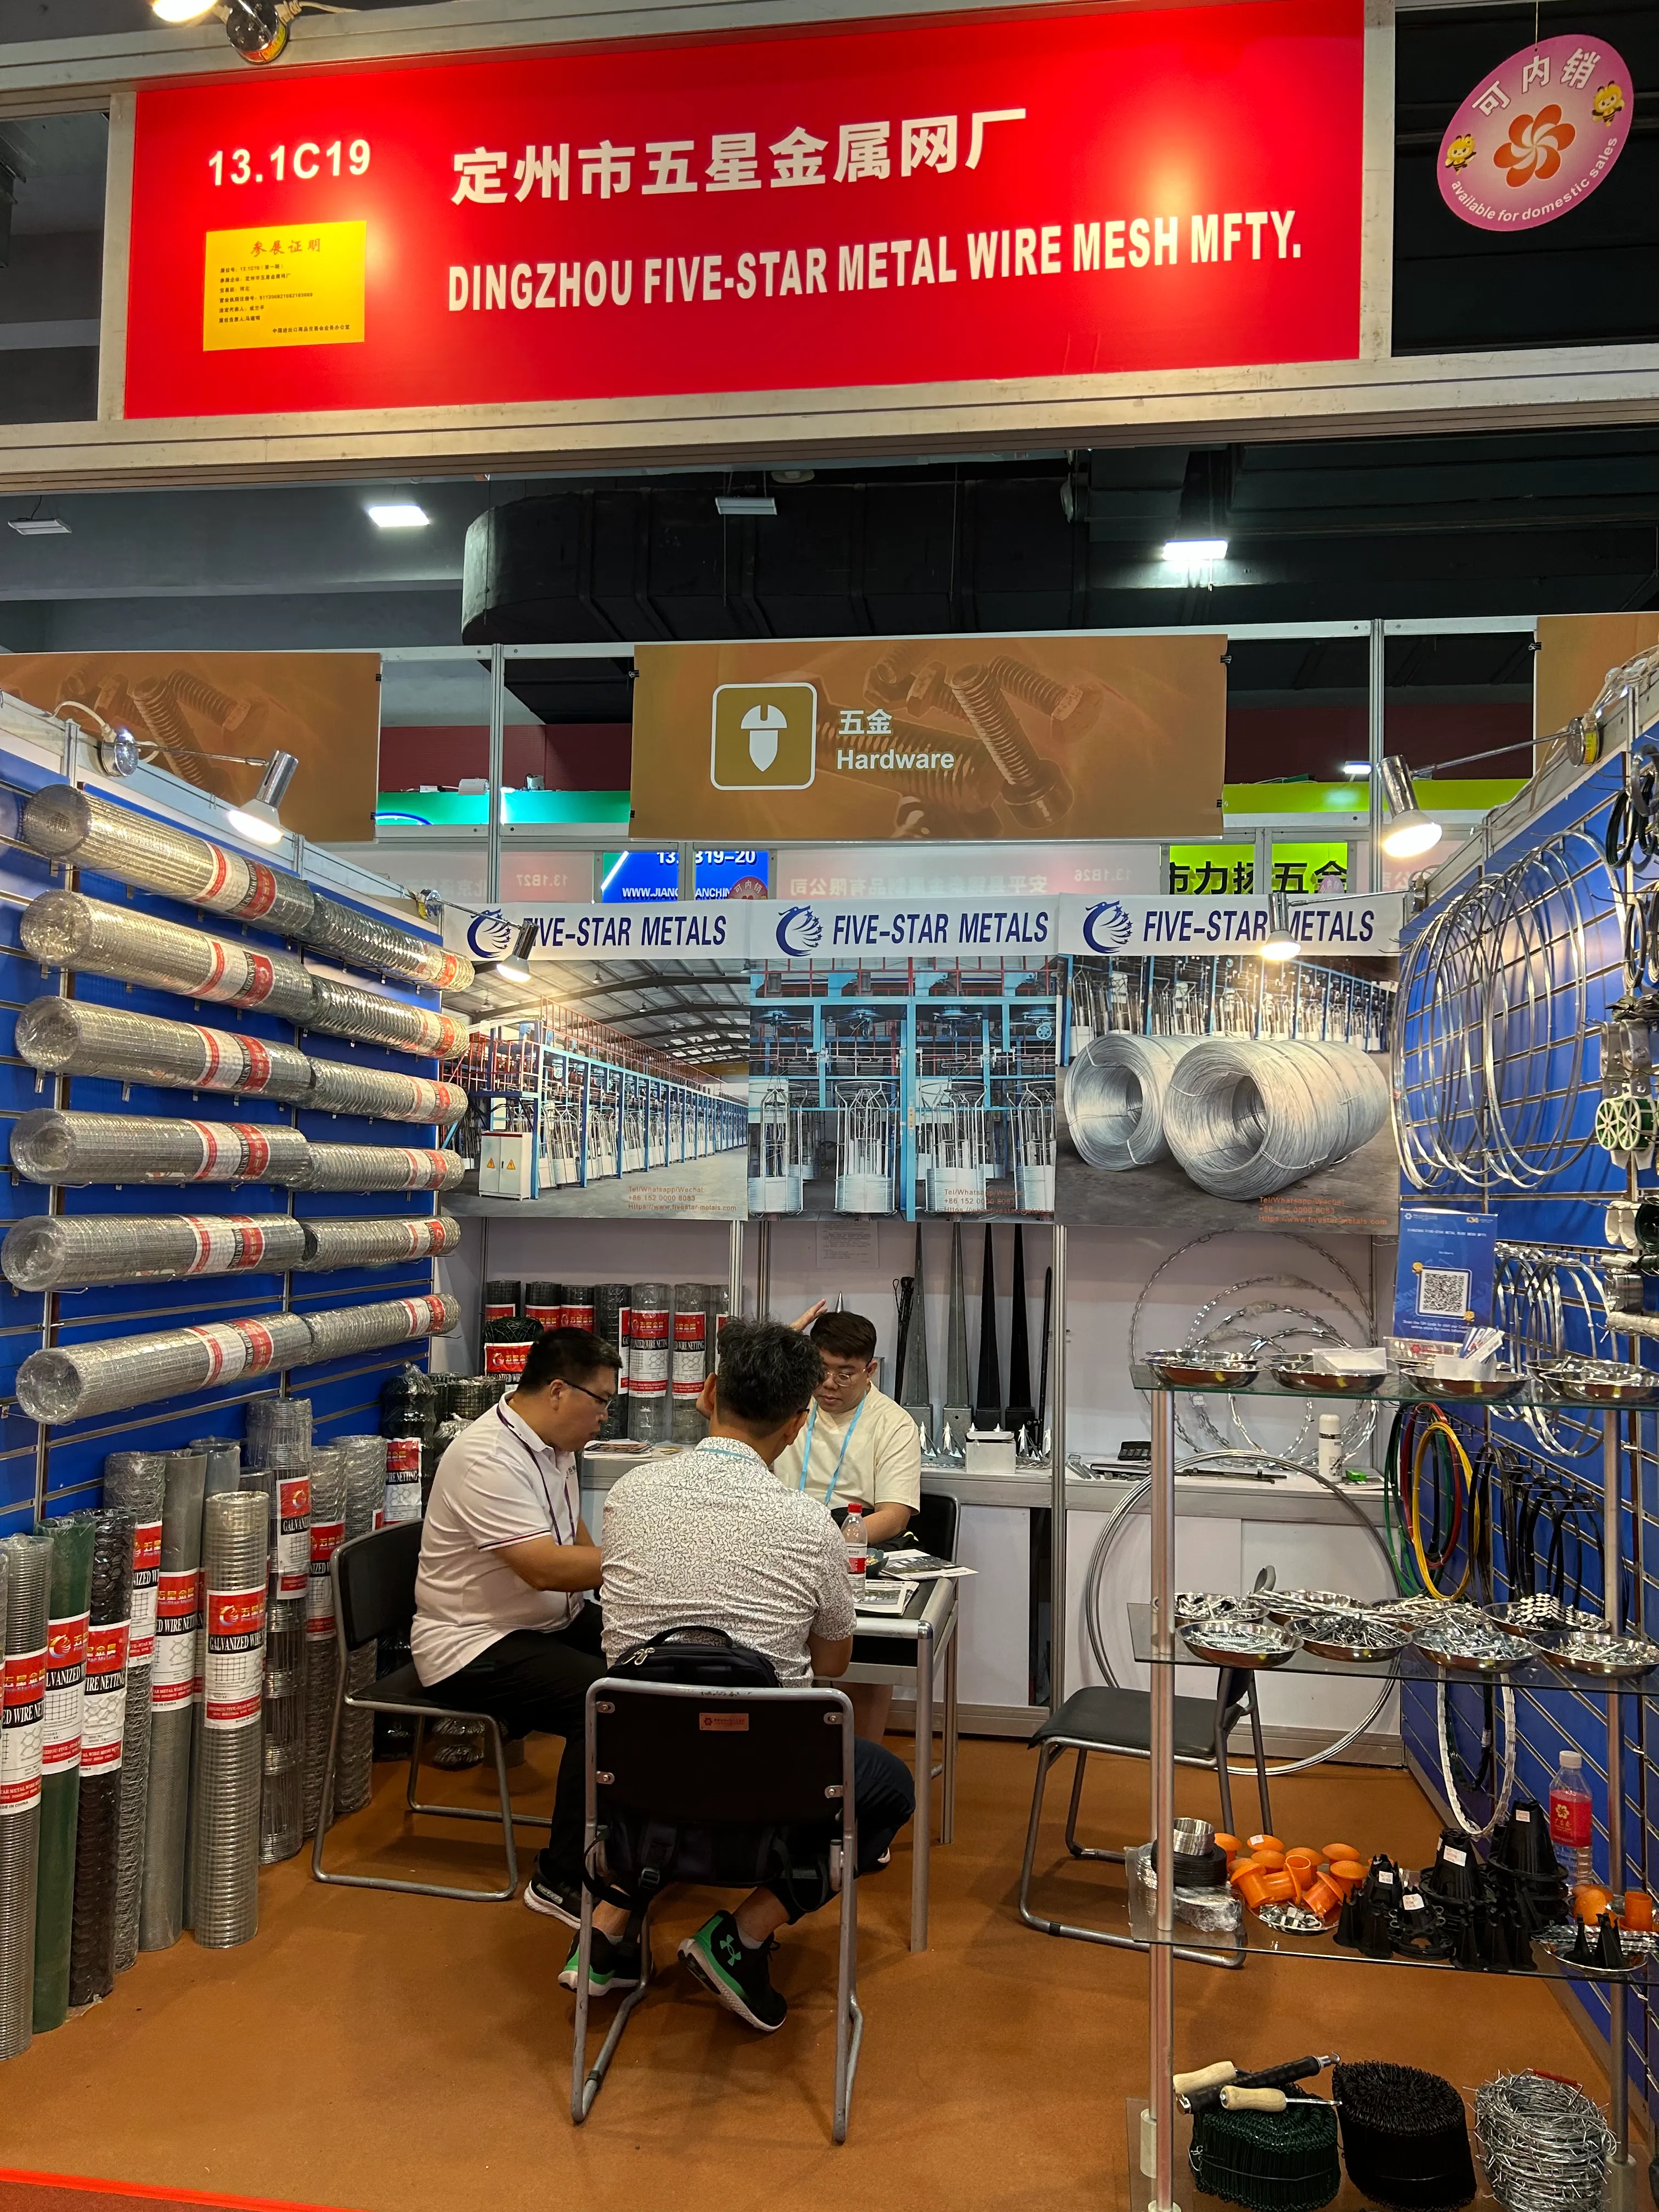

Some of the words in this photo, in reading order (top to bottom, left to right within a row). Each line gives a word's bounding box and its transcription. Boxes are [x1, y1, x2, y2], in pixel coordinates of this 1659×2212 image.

[1472, 48, 1600, 116] 可内销
[208, 139, 370, 185] 13.1C19
[450, 108, 1026, 205] 定州市五星金属网厂
[1452, 180, 1496, 219] available
[1498, 210, 1520, 222] for
[1522, 178, 1590, 219] domestic
[1589, 137, 1617, 178] sales
[251, 239, 321, 257] 参展证明
[449, 261, 632, 312] DINGZHOU
[644, 248, 827, 304] FIVE-STAR
[838, 236, 956, 291] METAL
[968, 226, 1060, 280] WIRE
[1073, 216, 1178, 272] MESH
[1191, 210, 1301, 263] MFTY.
[838, 709, 893, 736] 五金
[836, 748, 955, 770] Hardware
[734, 880, 763, 894] 可内销
[524, 916, 631, 947] VE-STAR
[640, 915, 726, 946] METALS
[833, 913, 948, 945] FIVE-STAR
[959, 912, 1048, 943] METALS
[1143, 910, 1267, 942] FIVE-STAR
[242, 1049, 252, 1065] WIRE
[241, 1140, 250, 1154] WIRE
[164, 1617, 182, 1632] WIRE
[210, 1635, 249, 1651] GALVANIZED
[47, 1666, 81, 1690] LVANIZED
[86, 1676, 99, 1692] IRE
[100, 1671, 125, 1690] NETTING
[14, 1705, 33, 1722] WIRE
